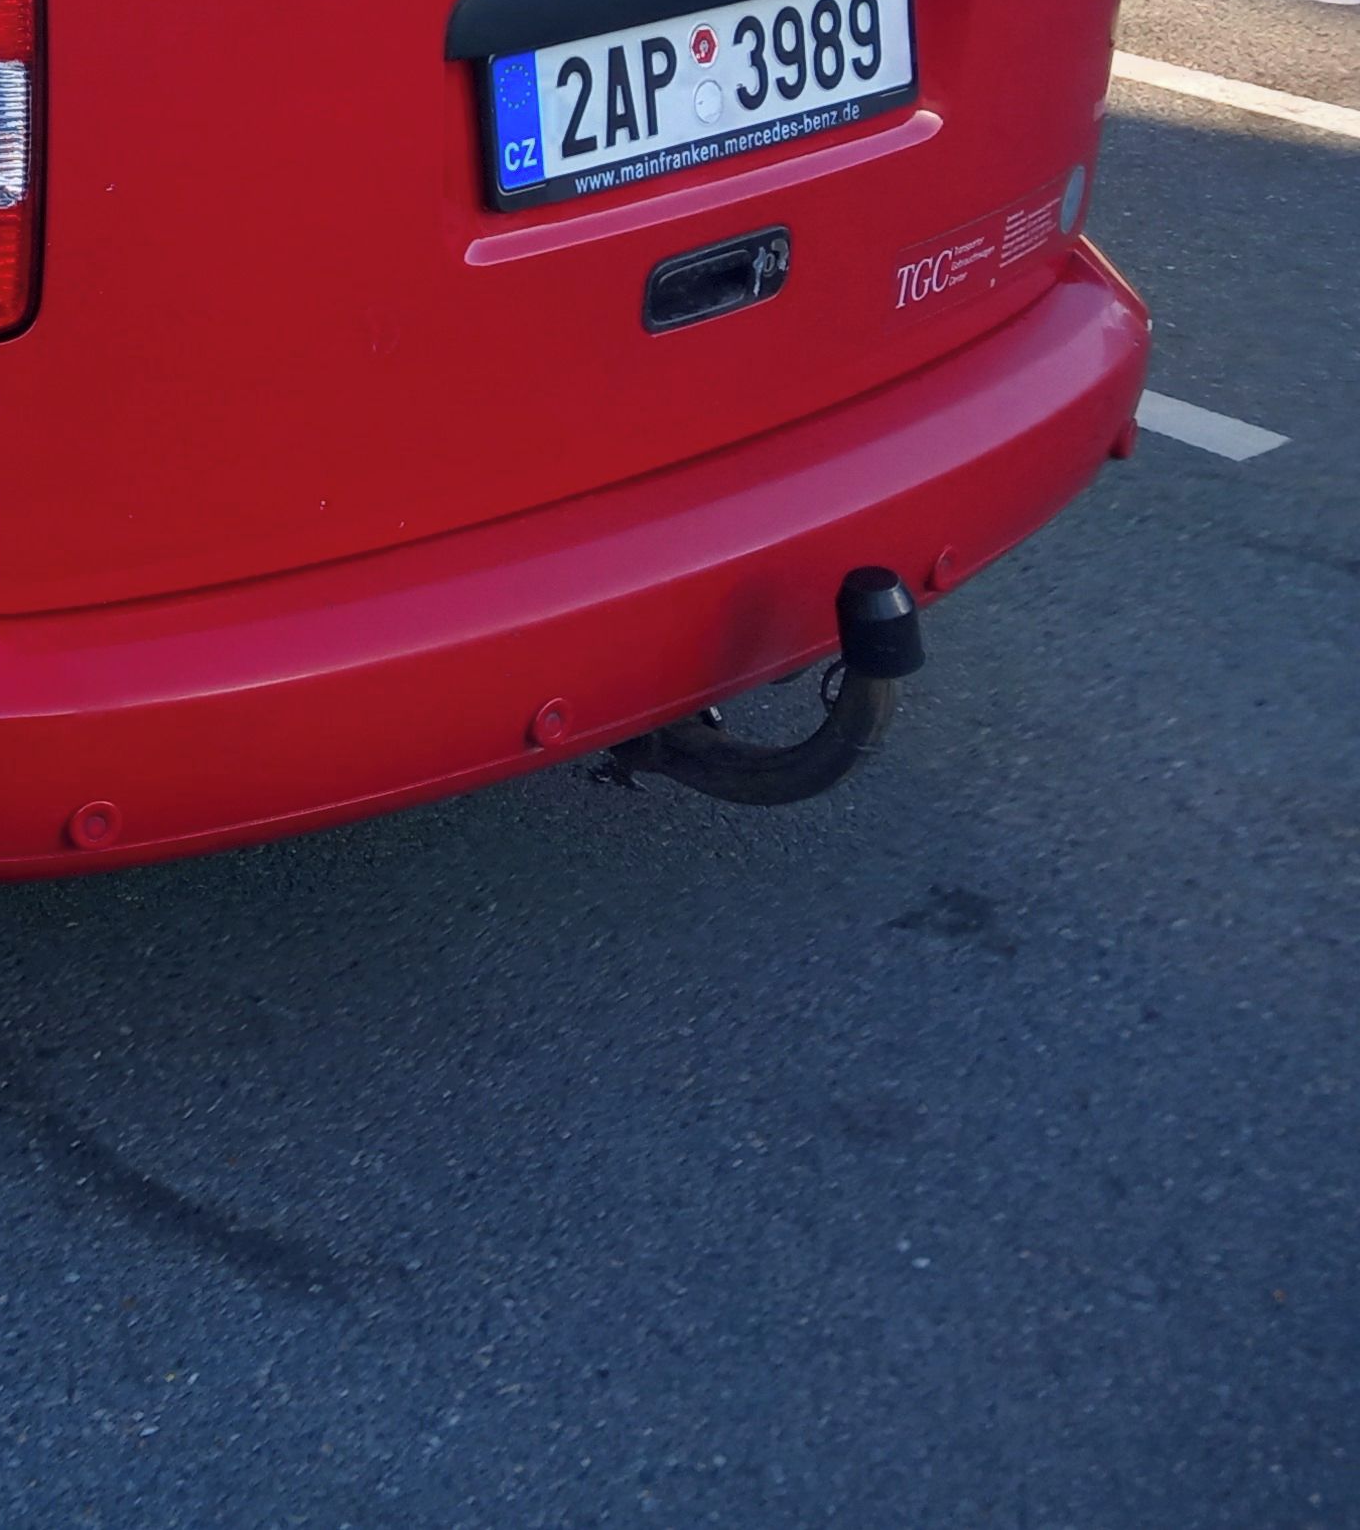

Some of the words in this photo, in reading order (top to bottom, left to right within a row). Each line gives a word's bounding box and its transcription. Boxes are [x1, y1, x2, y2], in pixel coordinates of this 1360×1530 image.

[556, 35, 677, 159] 2AP
[503, 137, 538, 171] CZ
[574, 102, 861, 195] www.mainfranken.mercedes-benz.de
[895, 248, 954, 309] TGC
